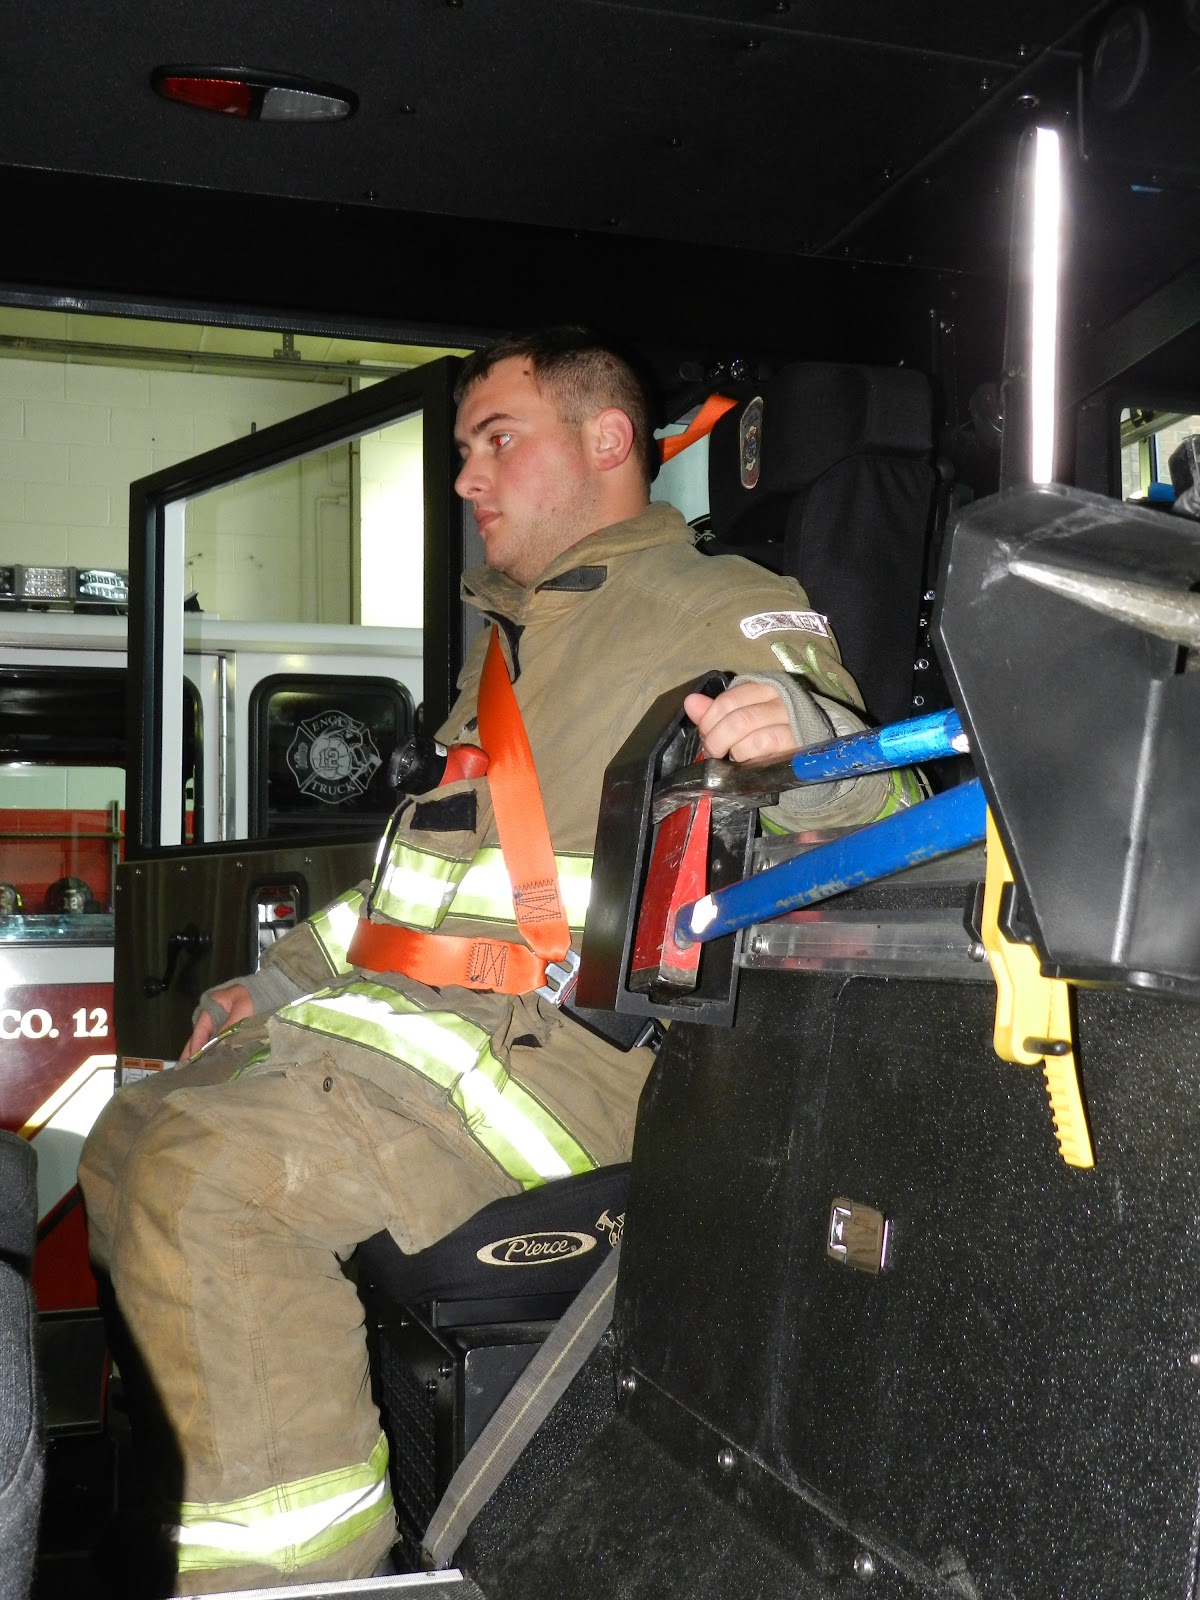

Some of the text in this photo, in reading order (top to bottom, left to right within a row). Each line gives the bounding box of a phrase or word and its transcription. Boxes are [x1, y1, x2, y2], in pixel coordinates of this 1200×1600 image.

[312, 715, 357, 733] ENGI
[319, 749, 339, 768] 12
[312, 780, 355, 796] TRUCK
[0, 1008, 108, 1039] CO. 12
[504, 1239, 569, 1261] Pierce
